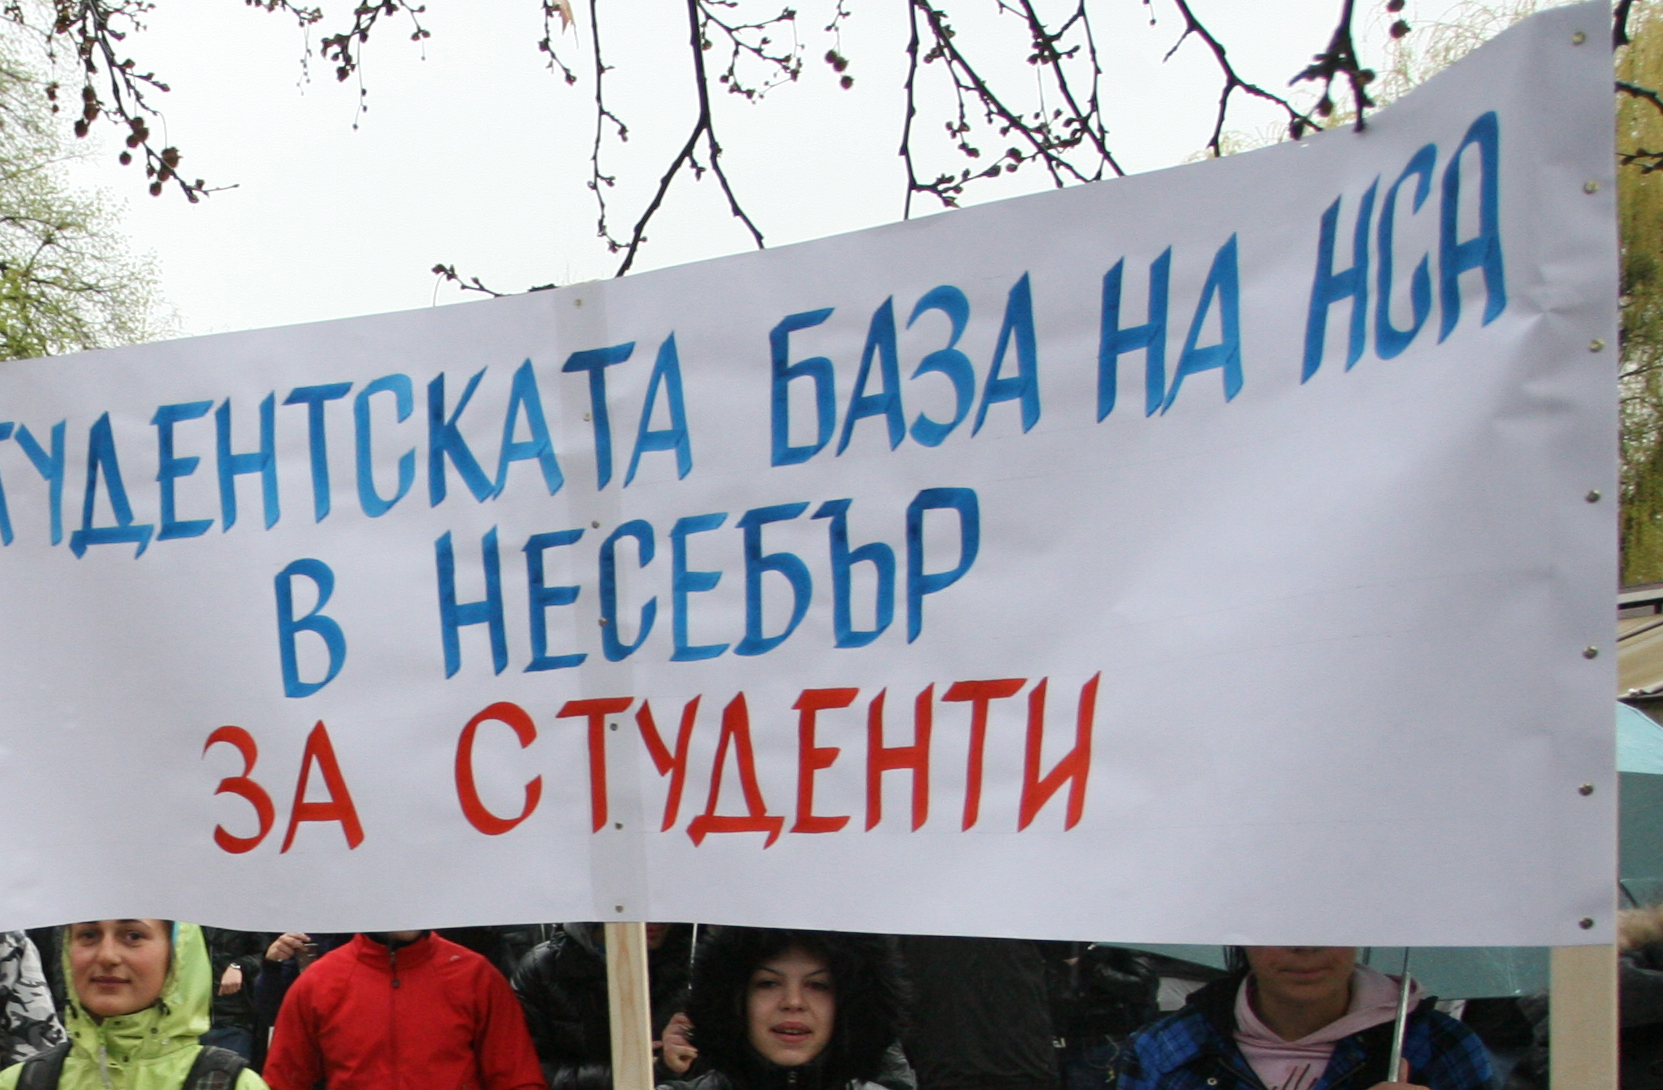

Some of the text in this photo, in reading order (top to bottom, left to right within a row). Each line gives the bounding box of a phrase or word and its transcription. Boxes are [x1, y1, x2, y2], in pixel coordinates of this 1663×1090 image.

[769, 270, 1040, 467] БАЗА
[1097, 232, 1244, 424] НА
[1301, 110, 1507, 385] НСА
[273, 487, 980, 698] В НЕСЕБЪР
[202, 671, 1101, 854] ЗА СТУДЕНТИ
